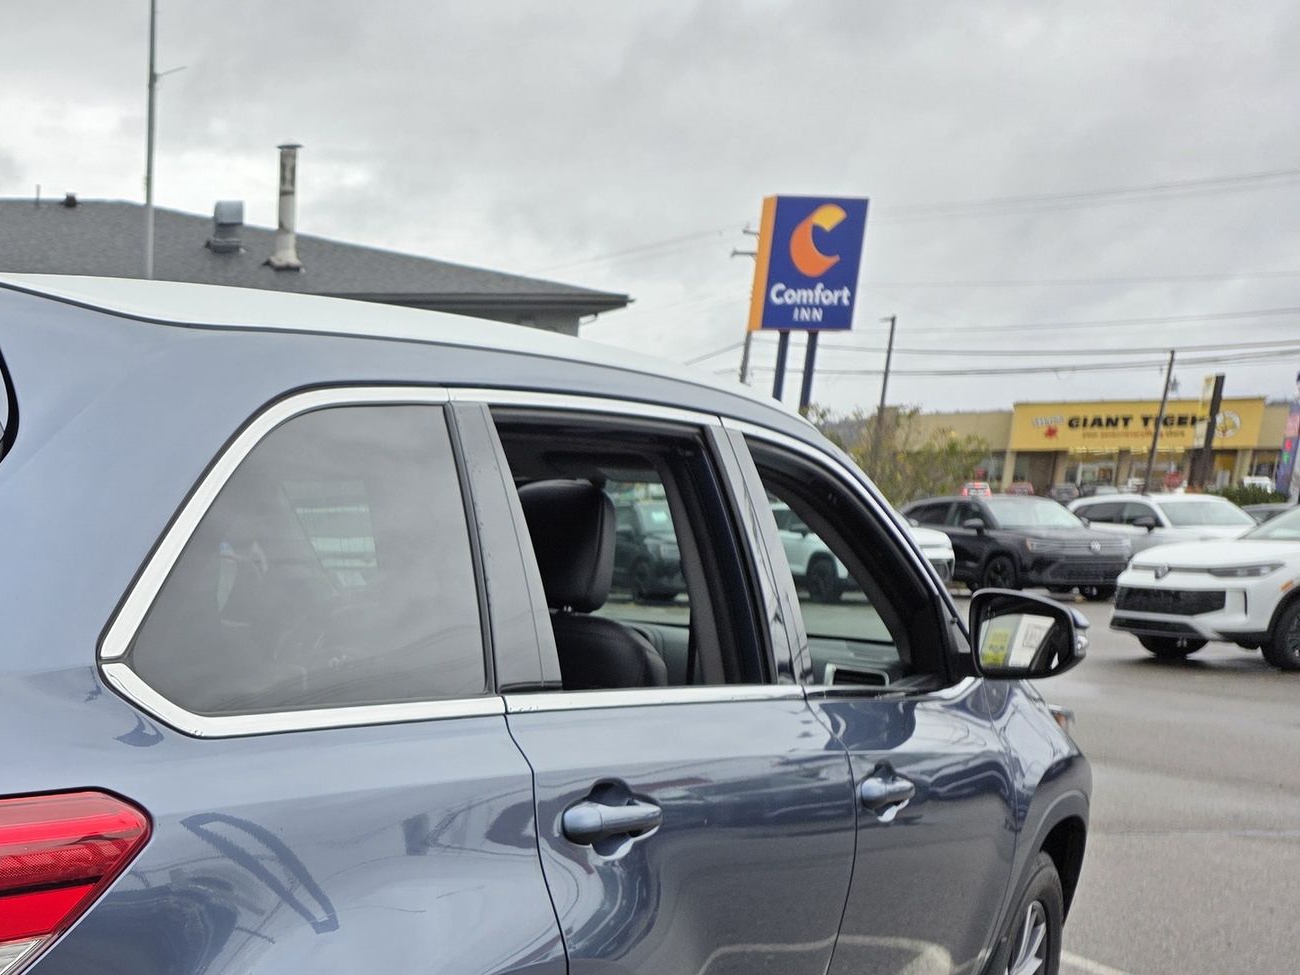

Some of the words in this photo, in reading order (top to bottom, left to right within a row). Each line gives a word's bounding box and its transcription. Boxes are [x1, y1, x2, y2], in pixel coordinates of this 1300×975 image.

[770, 283, 851, 305] Comfort
[792, 308, 823, 321] INN
[1068, 416, 1133, 429] GIANT
[1142, 416, 1198, 427] TGE
